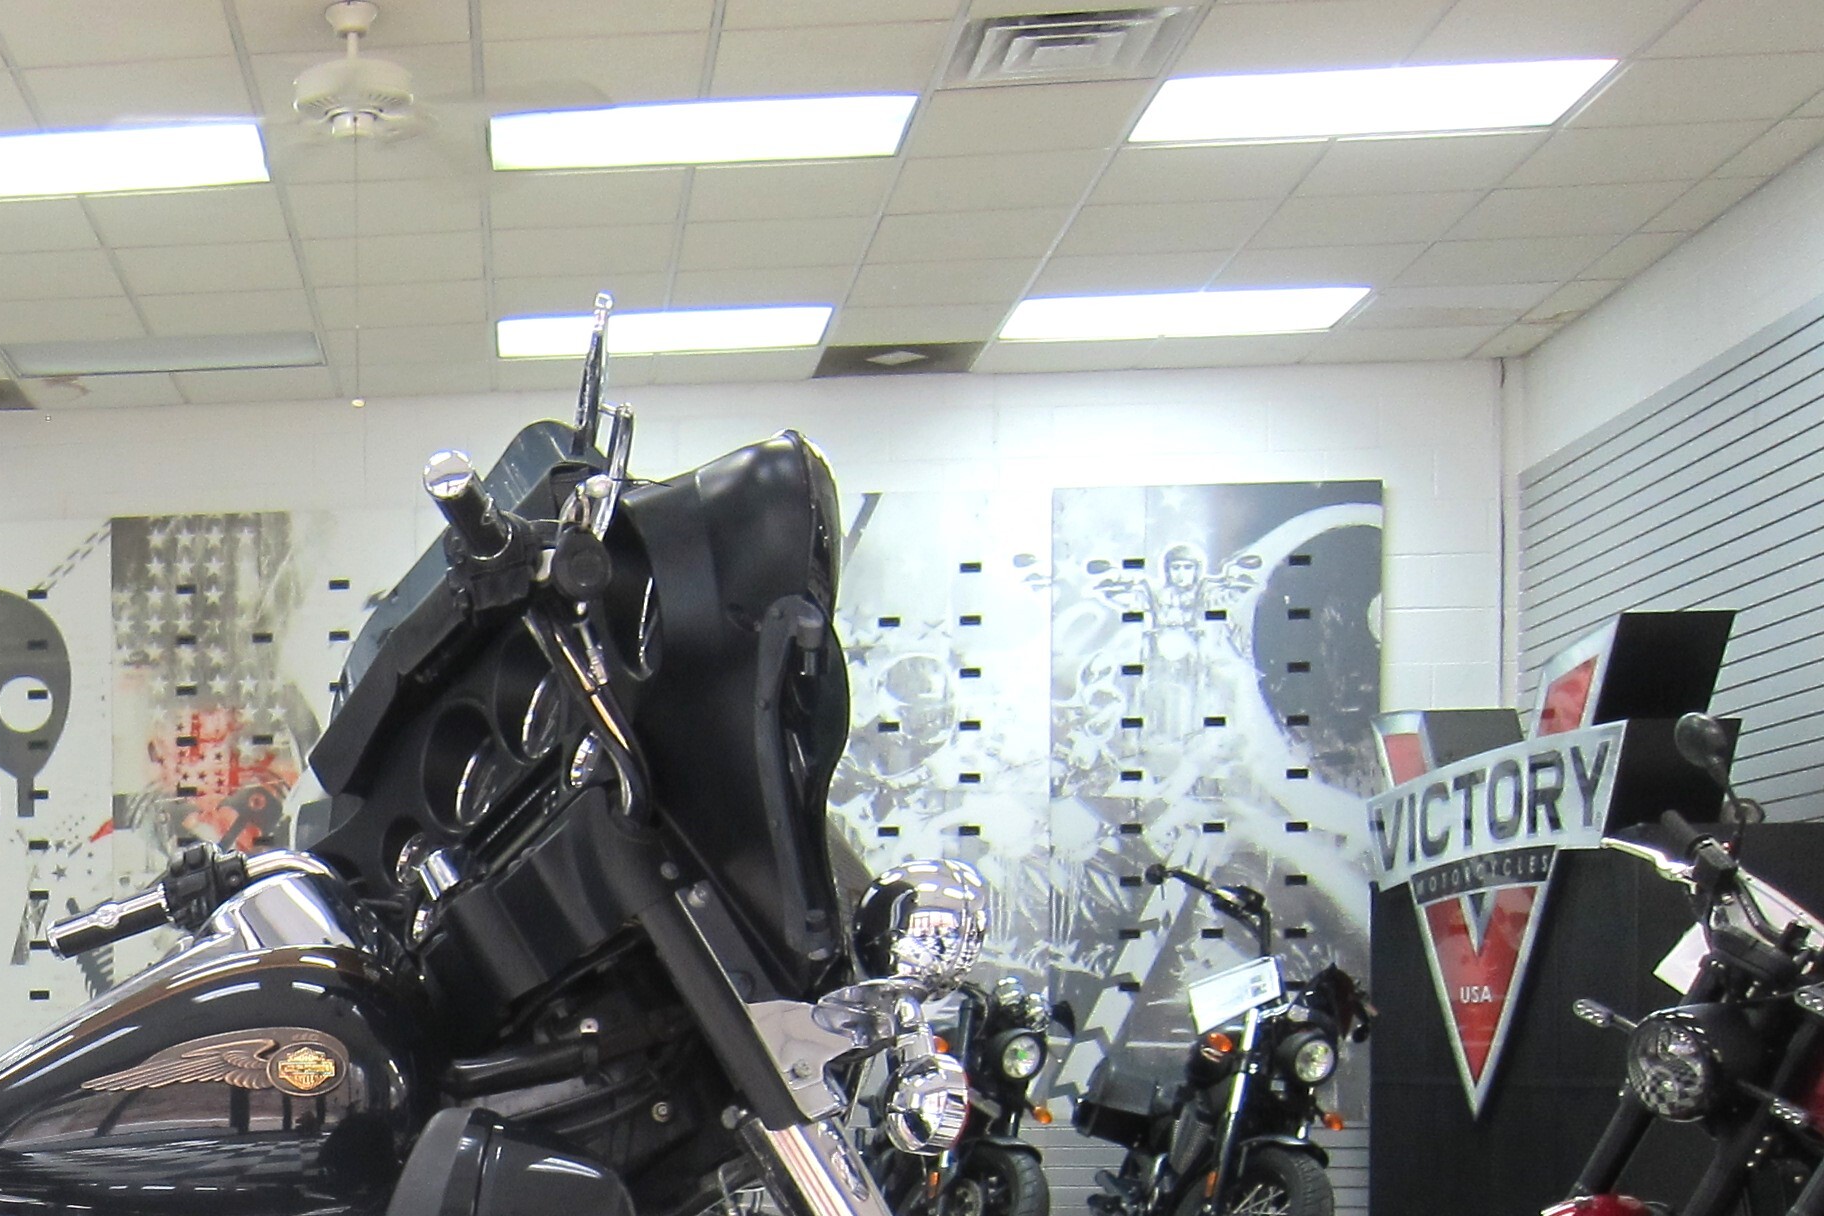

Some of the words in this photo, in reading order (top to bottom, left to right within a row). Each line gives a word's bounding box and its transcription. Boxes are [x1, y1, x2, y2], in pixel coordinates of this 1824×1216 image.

[1374, 739, 1613, 872] VICTORY
[1415, 855, 1550, 895] MOTORCYCLES
[1459, 985, 1493, 1004] USA
